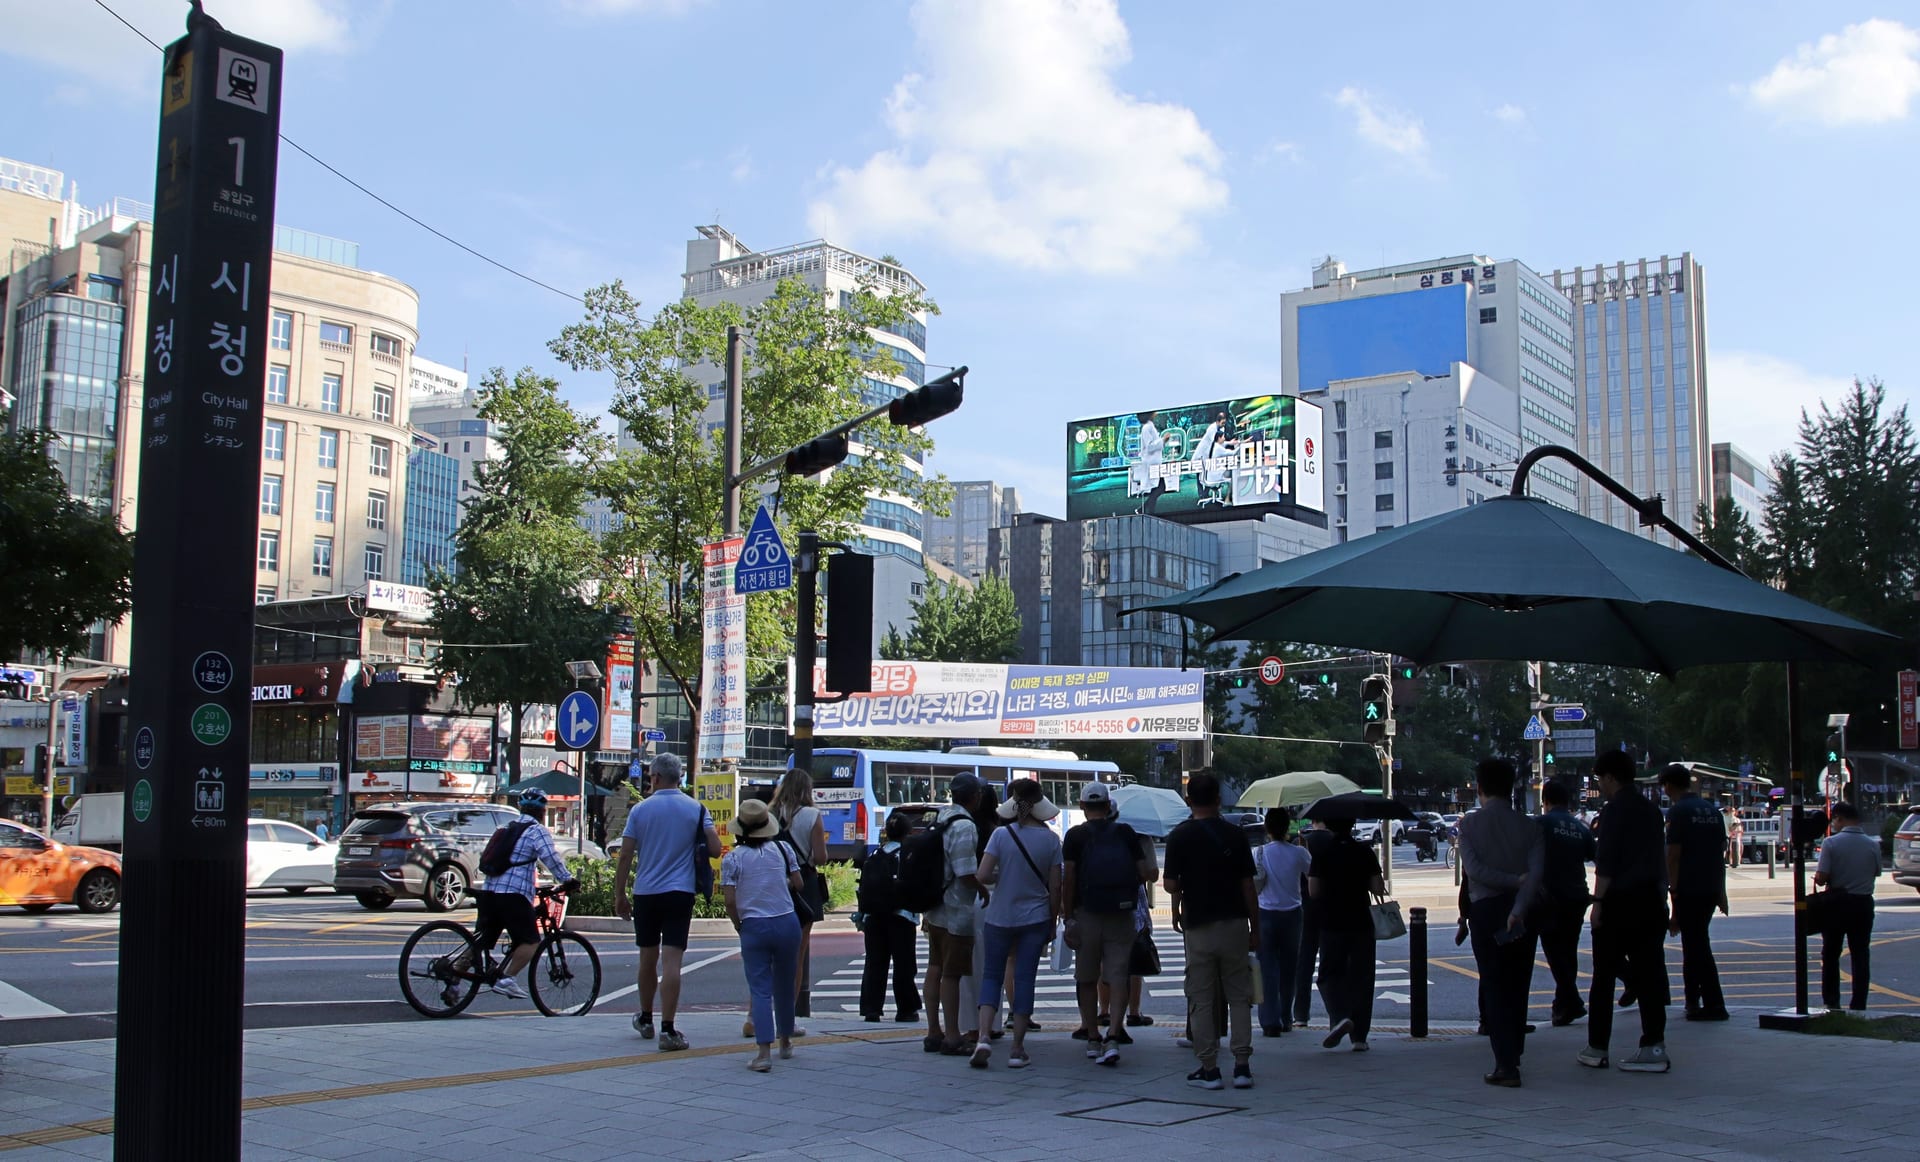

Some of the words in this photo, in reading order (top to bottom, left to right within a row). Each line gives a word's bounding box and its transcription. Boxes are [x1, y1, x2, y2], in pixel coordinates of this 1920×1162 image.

[227, 136, 246, 187] 1
[212, 201, 258, 222] Entrance
[208, 261, 251, 377] 시청
[201, 391, 225, 408] City
[226, 397, 249, 410] Hall
[203, 432, 244, 449] シチョン
[1239, 438, 1290, 469] 미래
[1303, 459, 1315, 475] LG
[739, 568, 787, 590] 자전거횡단
[205, 659, 221, 669] 132
[1264, 663, 1280, 678] 50
[199, 670, 226, 685] 1호선
[1010, 676, 1041, 690] 이재명
[1043, 675, 1063, 687] 독재
[1065, 673, 1085, 686] 정권
[1087, 671, 1110, 684] 심판!
[1006, 694, 1036, 713] 나라
[1039, 692, 1070, 709] 걱정,
[1136, 687, 1156, 700] 함께
[1158, 683, 1199, 698] 해주세요!
[204, 711, 220, 720] 201
[813, 697, 868, 728] 원이
[870, 690, 998, 722] 되어주세요!
[197, 723, 225, 736] 2호선
[1002, 721, 1033, 732] 당원가입
[1141, 717, 1200, 733] 자유통일당
[521, 756, 548, 768] world
[269, 768, 292, 782] GS25
[833, 766, 850, 778] 400
[698, 784, 733, 800] 교통안내
[204, 816, 226, 828] 80m
[1553, 827, 1583, 840] POLICE
